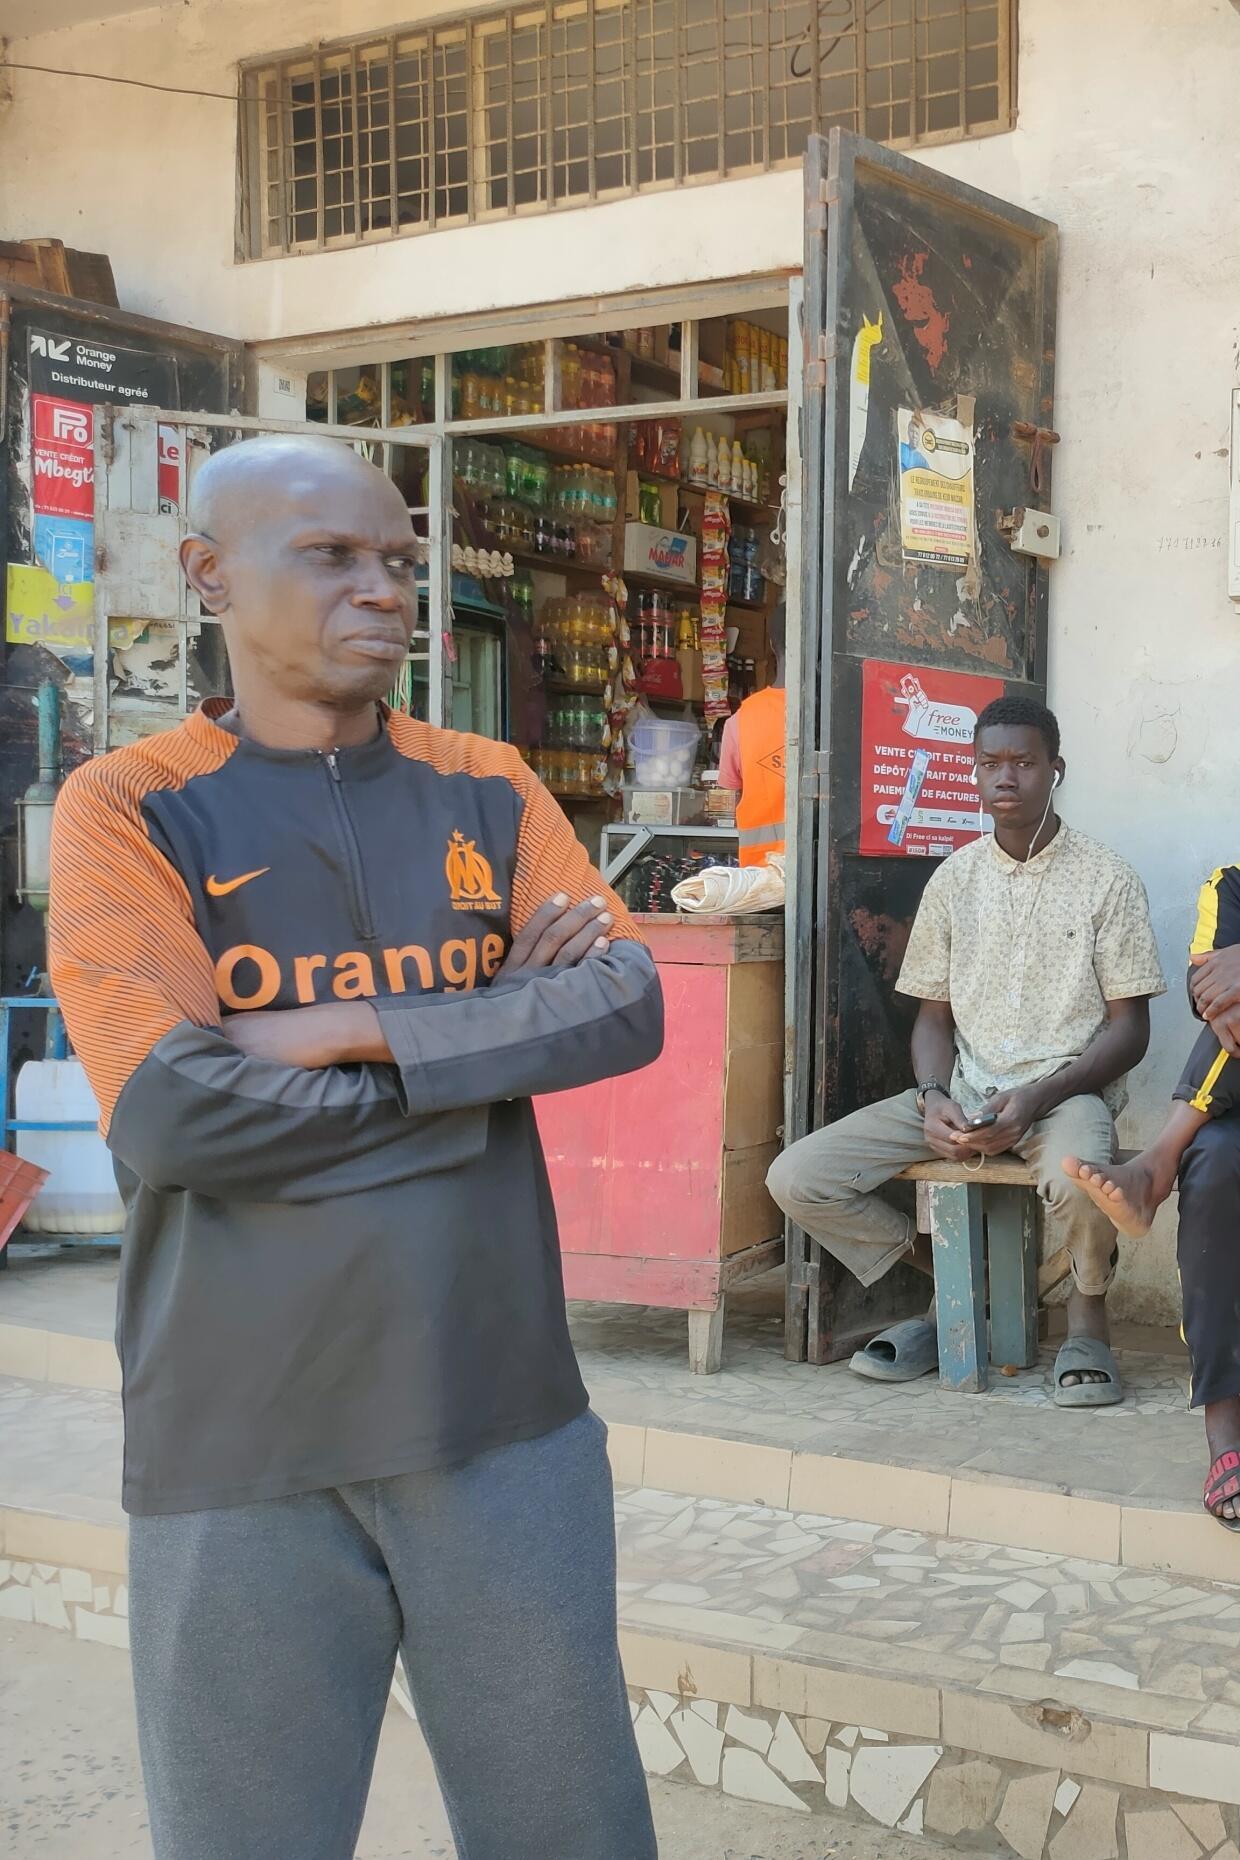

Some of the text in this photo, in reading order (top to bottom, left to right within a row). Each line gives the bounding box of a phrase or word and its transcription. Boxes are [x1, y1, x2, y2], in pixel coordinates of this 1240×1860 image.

[76, 345, 117, 362] Orange
[76, 355, 113, 372] Money
[51, 371, 149, 398] Distributeur agréé
[53, 408, 88, 442] Pro
[928, 709, 961, 727] free
[875, 745, 906, 758] VENTE
[907, 748, 942, 762] CDIT
[943, 754, 954, 763] ET
[921, 789, 933, 799] DE
[935, 789, 980, 803] FACTURES
[214, 933, 505, 1010] Orange
